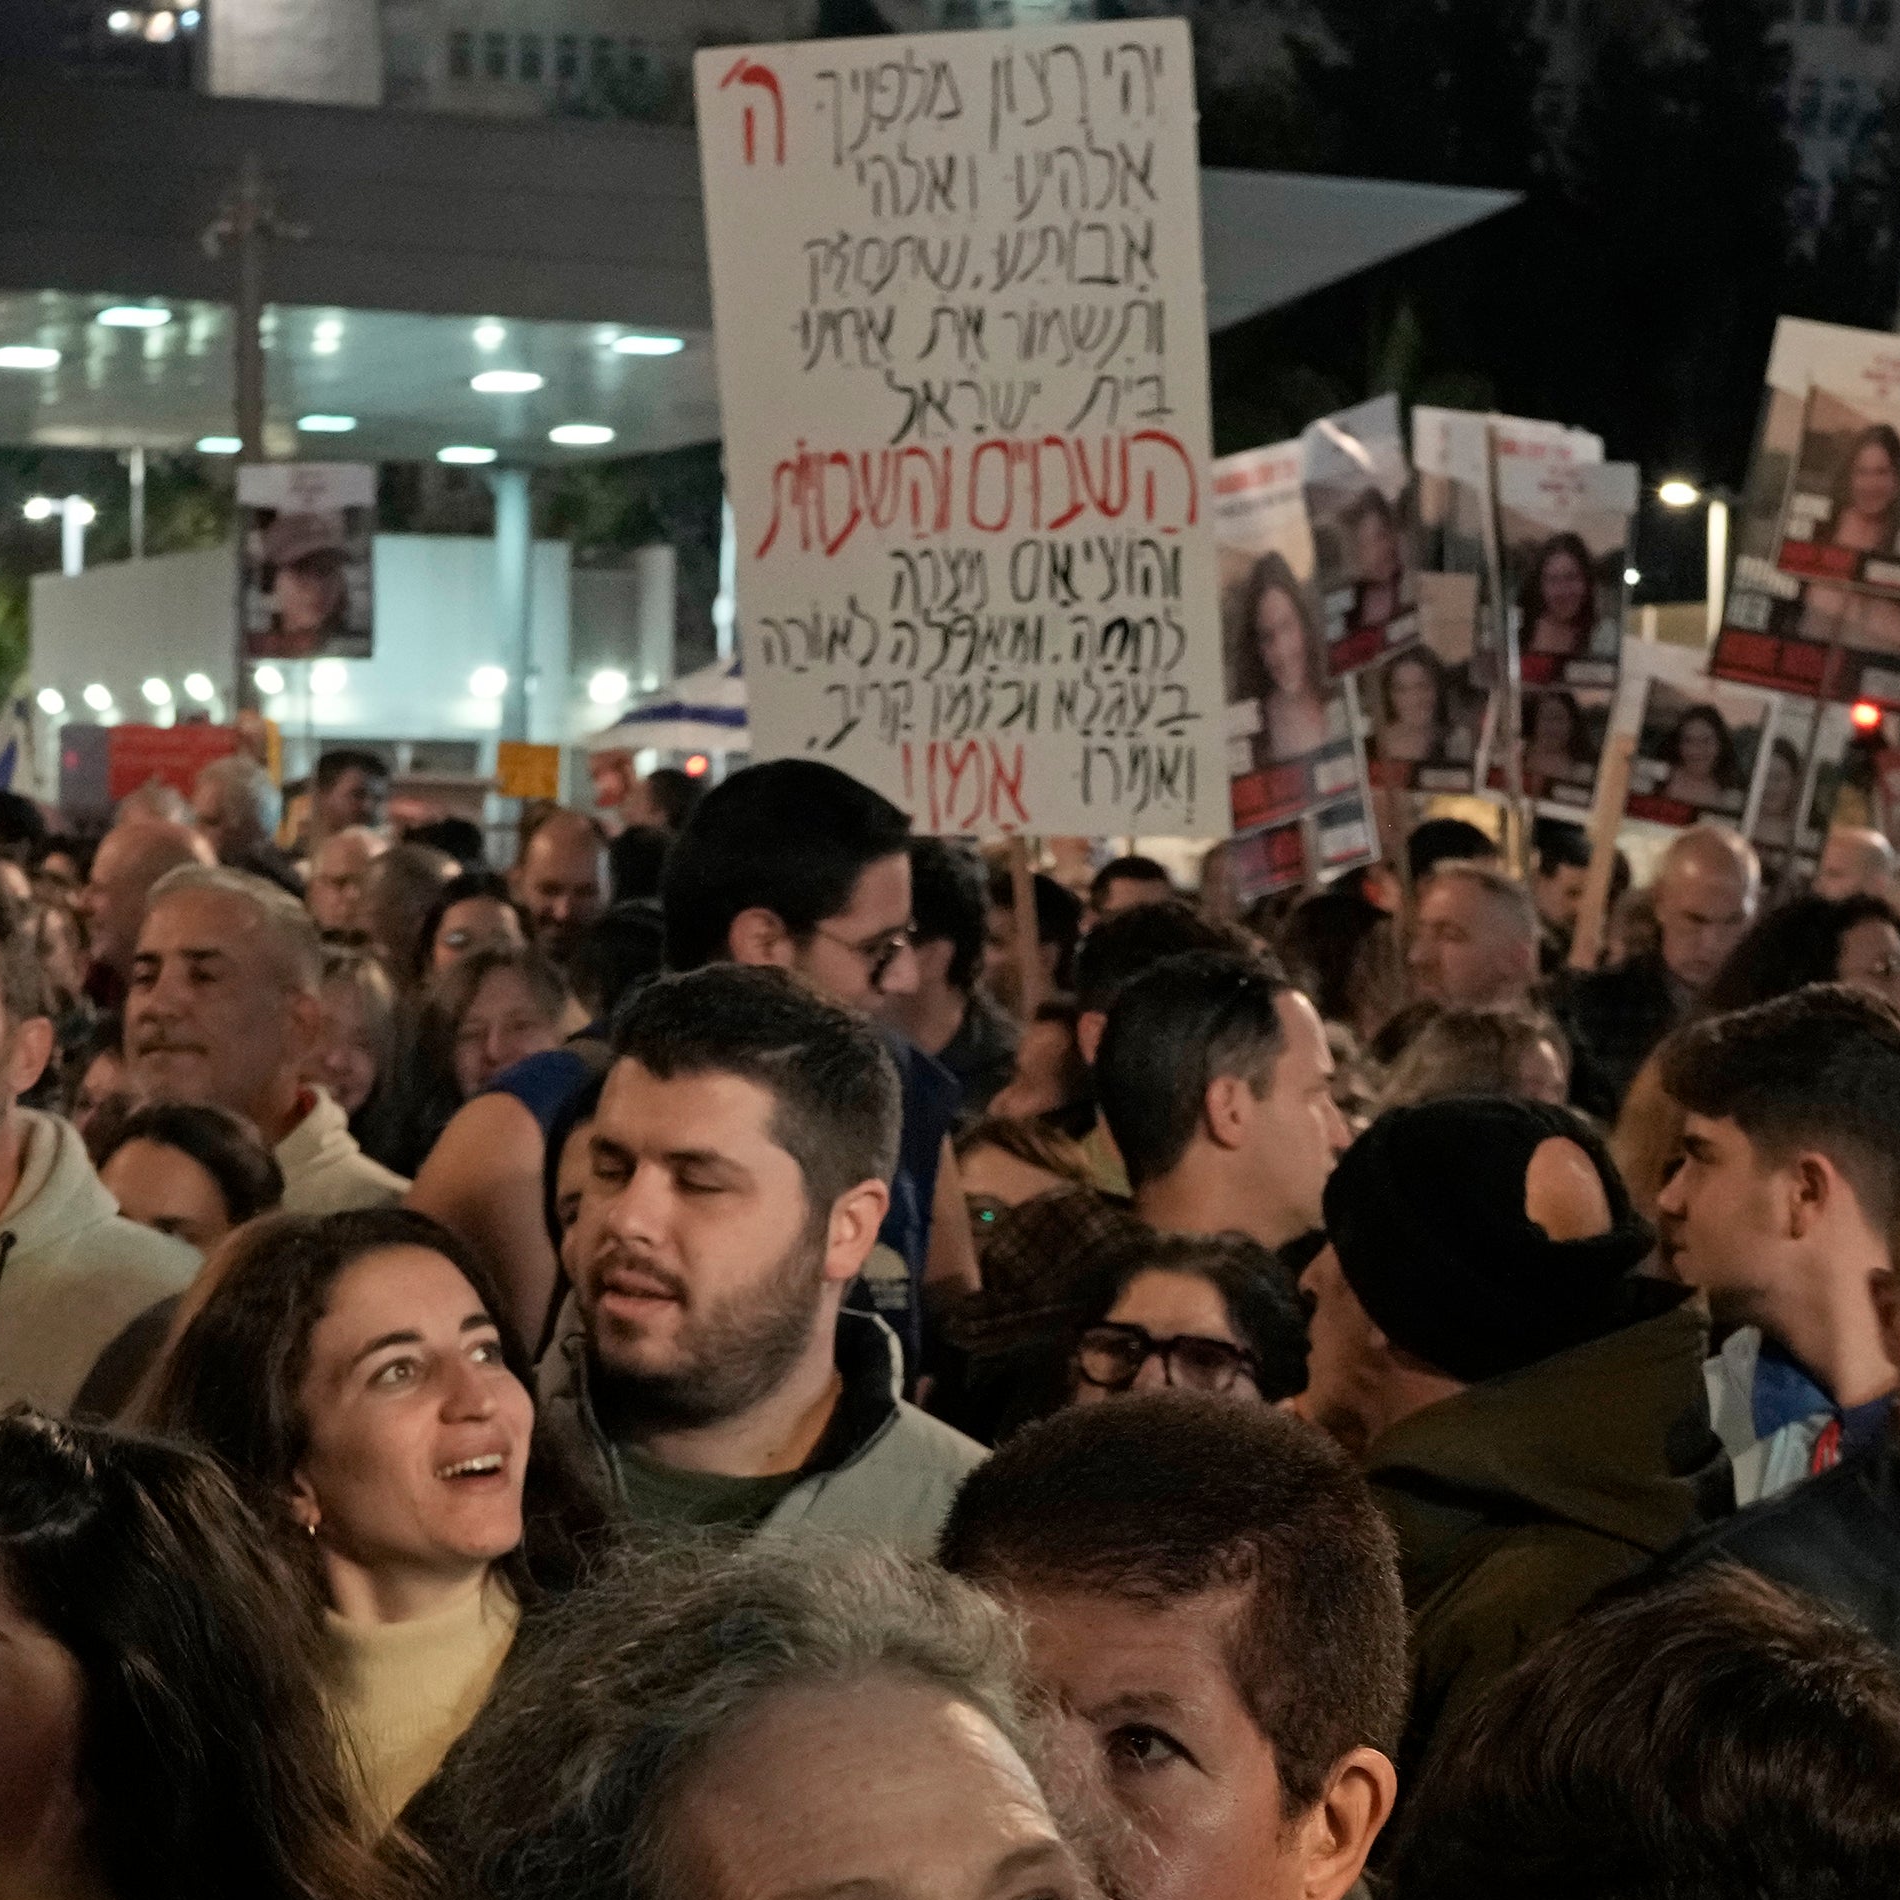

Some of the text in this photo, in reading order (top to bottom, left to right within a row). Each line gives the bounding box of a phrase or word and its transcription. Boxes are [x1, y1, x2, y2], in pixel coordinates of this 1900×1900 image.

[987, 42, 1089, 154] רצון
[1102, 42, 1164, 119] יהי
[916, 304, 990, 364] את
[889, 367, 1175, 446] בית ישראל
